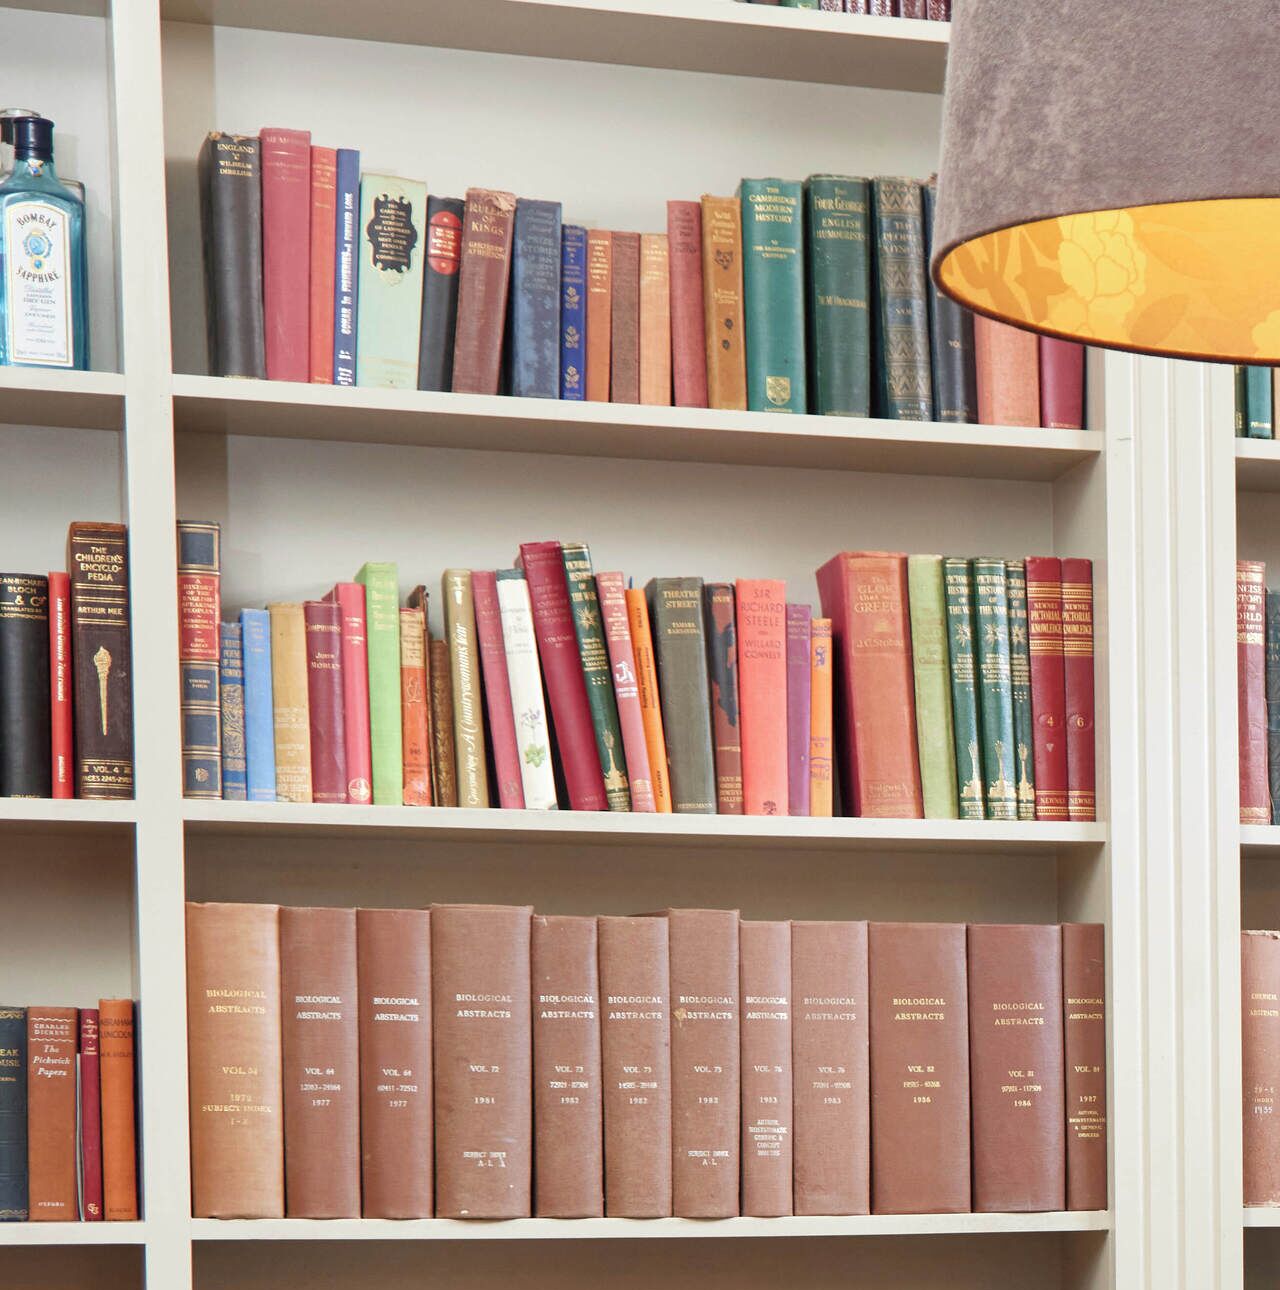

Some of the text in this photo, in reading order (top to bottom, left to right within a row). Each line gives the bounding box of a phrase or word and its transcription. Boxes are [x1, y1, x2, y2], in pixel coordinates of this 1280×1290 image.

[217, 143, 254, 153] ENGLAND
[749, 194, 797, 206] CAMBRIDGE
[754, 204, 793, 213] MODERN
[16, 213, 57, 229] BOMBAY
[755, 213, 793, 224] HISTORY
[471, 221, 505, 235] KINGS
[16, 266, 61, 283] SAPPHIRE
[90, 546, 107, 554] THE
[74, 552, 125, 564] CHILDREN'S
[80, 561, 123, 573] ENCYCLO-
[88, 572, 114, 582] PEDIA
[7, 586, 37, 594] BLOCH
[663, 590, 698, 599] THEATRE
[753, 588, 771, 599] SIR
[665, 600, 698, 608] STREET
[741, 602, 783, 613] RICHARD
[77, 606, 123, 615] ARTHUR MEE
[745, 616, 780, 626] STEELE
[744, 639, 782, 649] WILLARD
[1047, 716, 1054, 727] 4
[1077, 717, 1084, 727] 6
[456, 994, 513, 1003] BIOLOGICAL
[540, 995, 595, 1004] BIOLOGICAL
[608, 996, 663, 1004] BIOLOGICAL
[893, 998, 946, 1006] BIOLOGICAL
[993, 1003, 1045, 1011] BIOLOGICAL
[456, 1010, 511, 1018] ABSTRACTS
[540, 1010, 595, 1019] ABSTRACTS
[609, 1012, 663, 1020] ABSTRACTS
[43, 1045, 60, 1053] The
[38, 1067, 67, 1077] Papers
